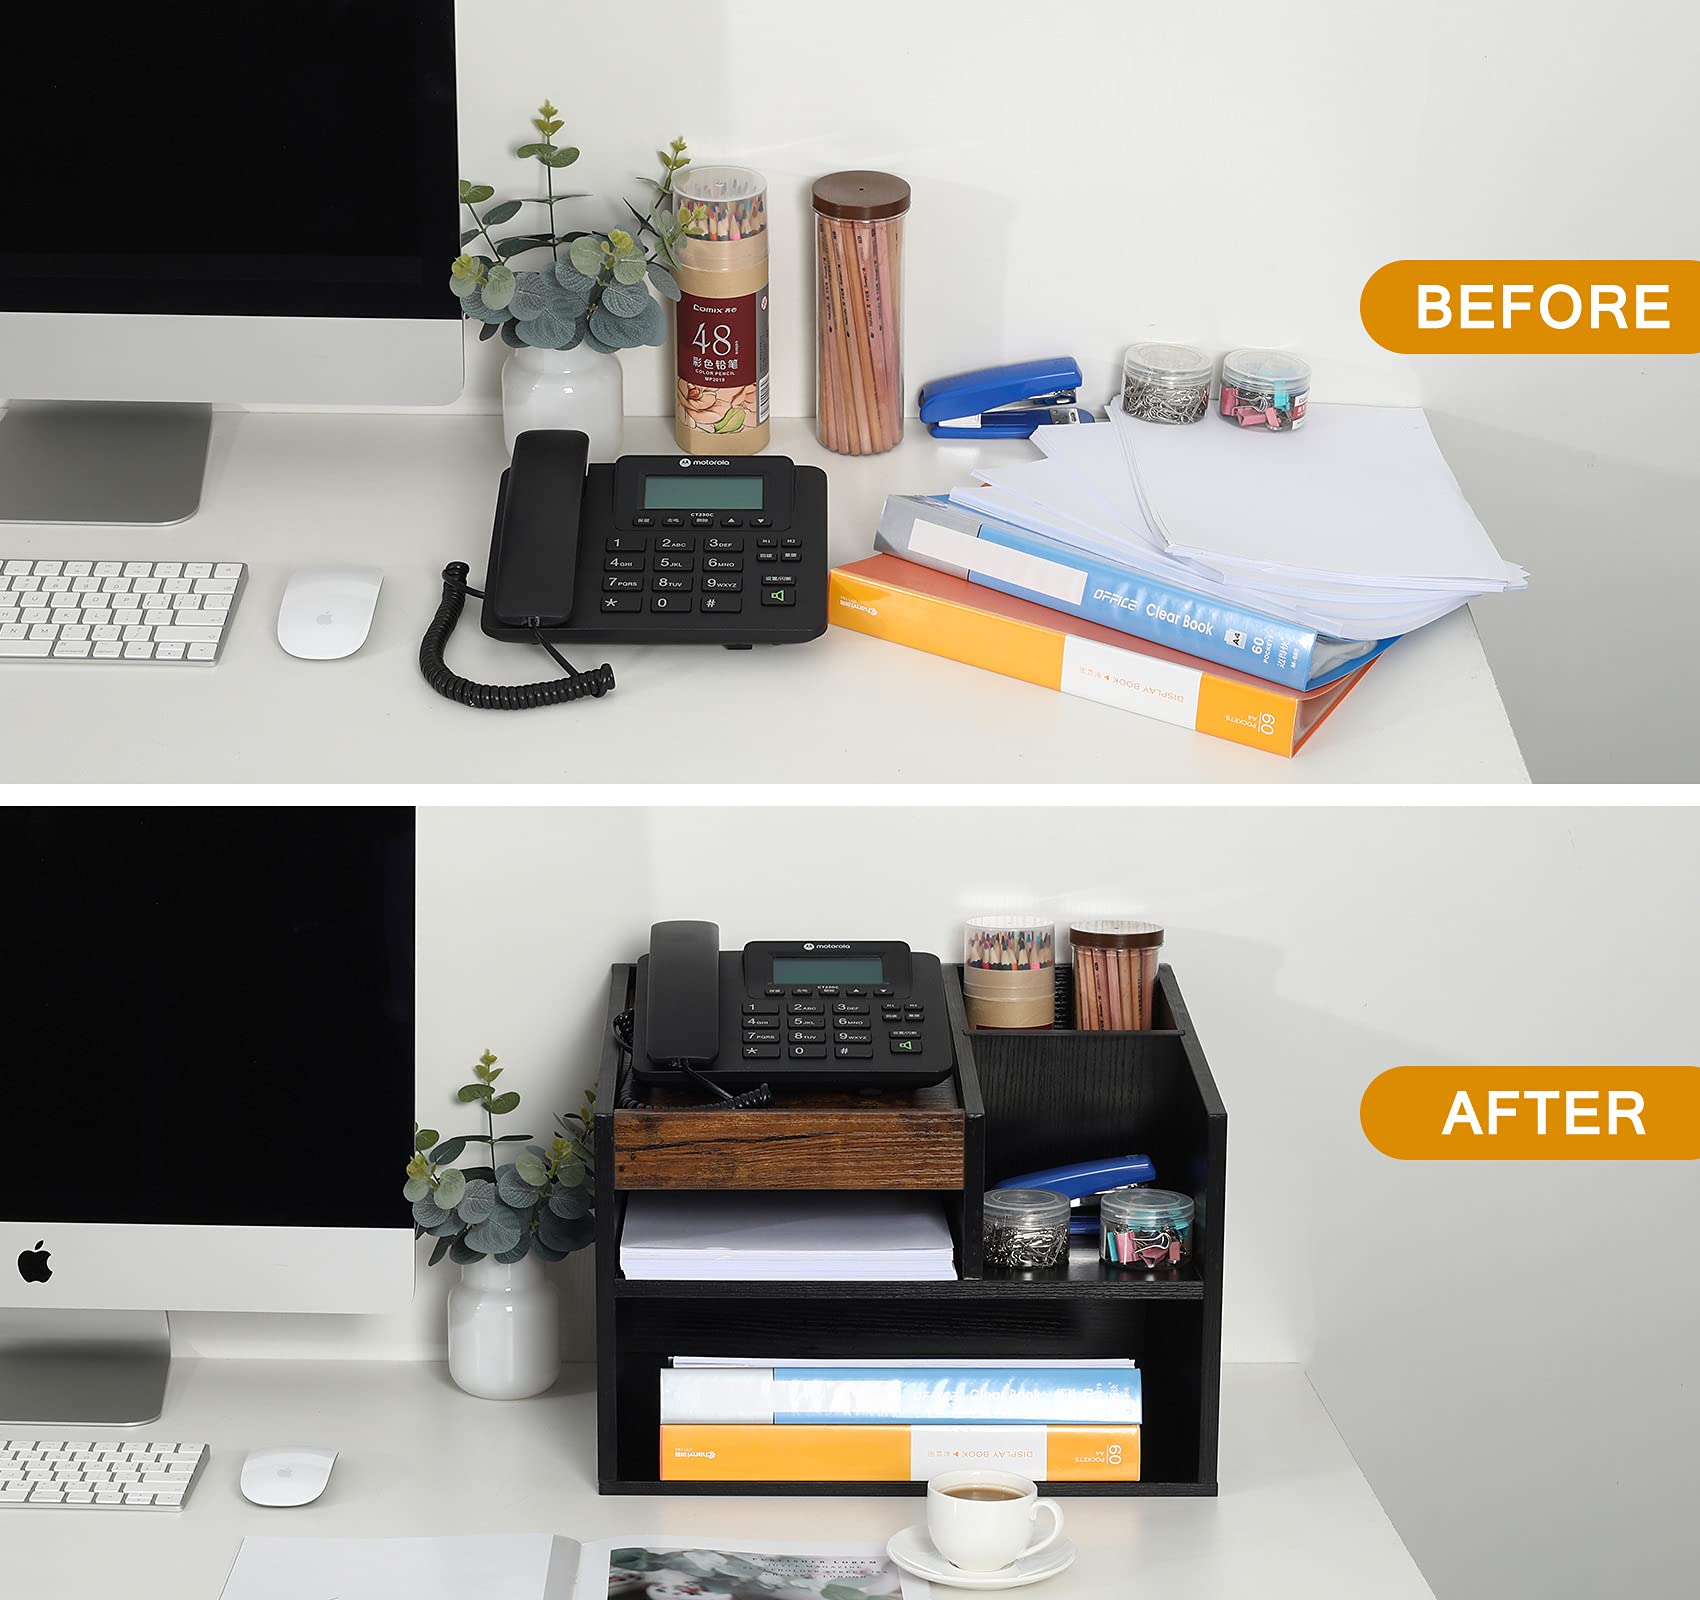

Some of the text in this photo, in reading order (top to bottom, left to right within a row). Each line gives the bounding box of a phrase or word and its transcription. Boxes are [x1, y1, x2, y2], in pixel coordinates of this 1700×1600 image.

[691, 322, 732, 356] 48
[692, 356, 738, 370] 彩色铅笔
[695, 368, 714, 376] COLOR
[614, 539, 621, 547] 1
[657, 598, 667, 608] 0
[1093, 589, 1213, 637] OFFICE Clear Book
[1231, 632, 1241, 646] A4
[1251, 637, 1265, 655] 60
[1113, 676, 1184, 703] DISPLAY BOOK
[1225, 714, 1257, 729] POCKETS
[1259, 713, 1275, 735] 60
[962, 1450, 1033, 1458] DISPLAY BOOK
[1109, 1444, 1122, 1465] 60
